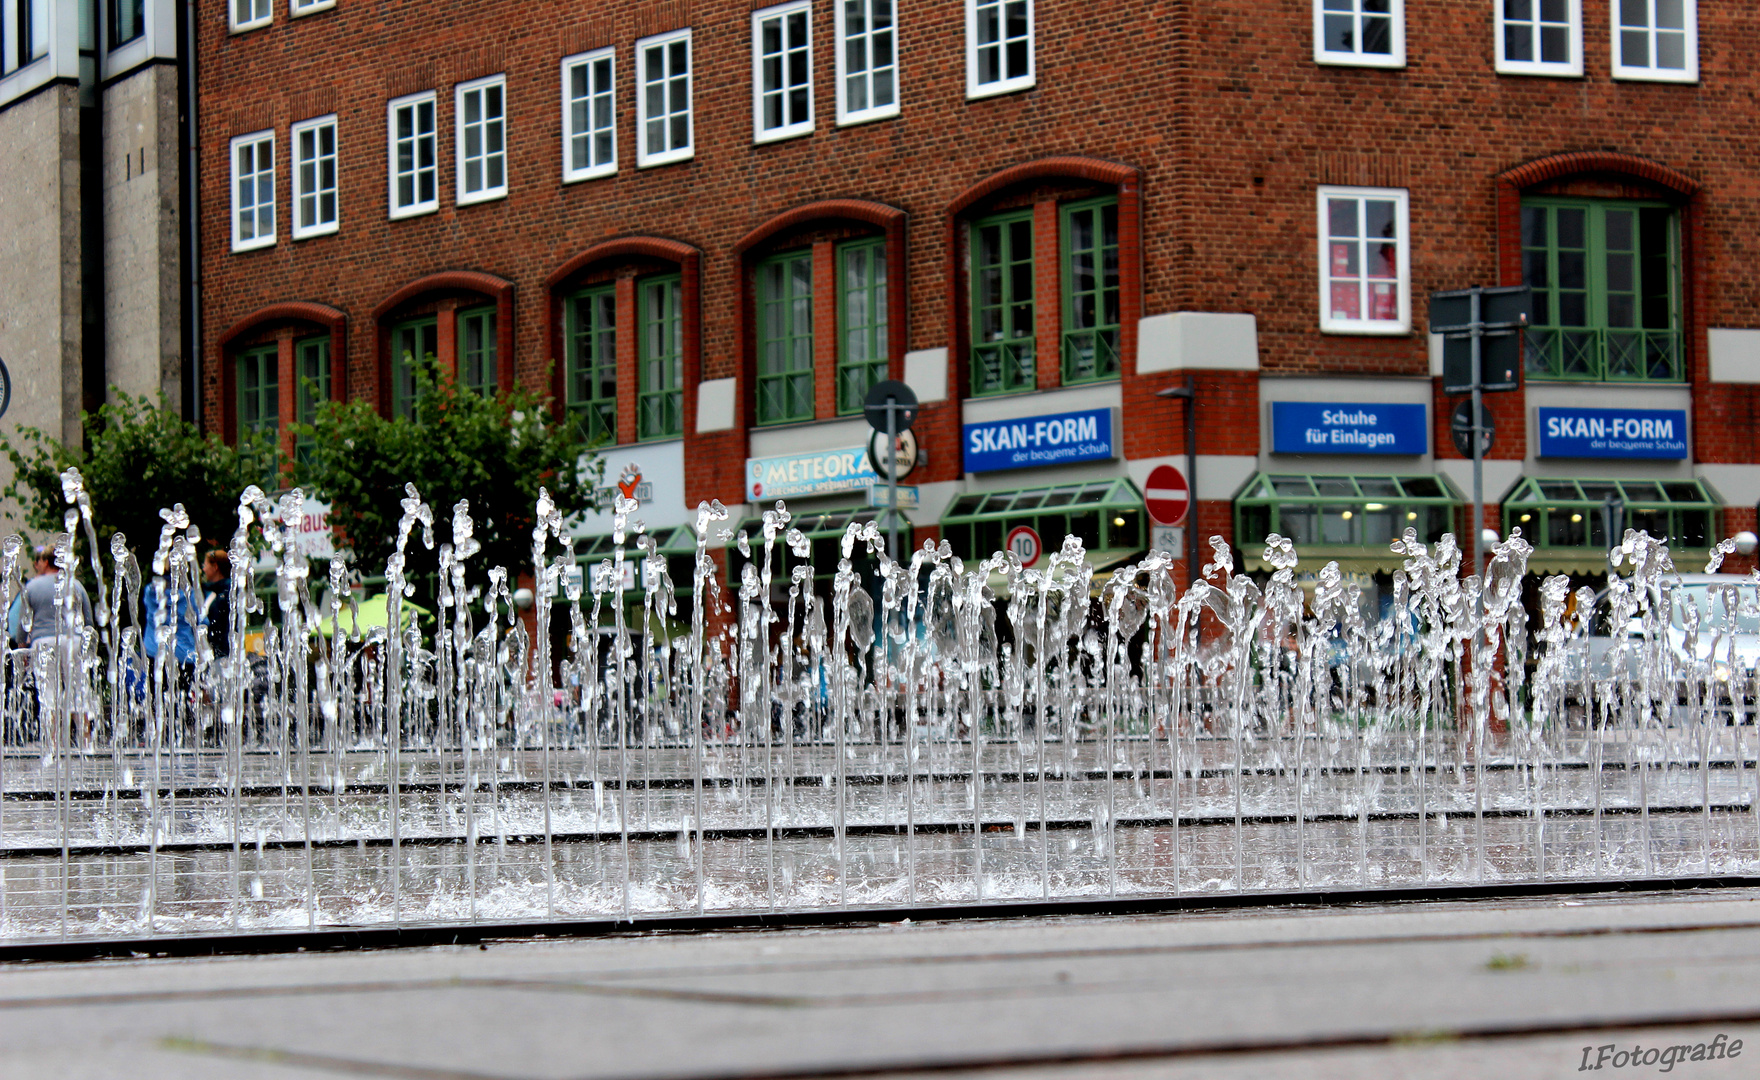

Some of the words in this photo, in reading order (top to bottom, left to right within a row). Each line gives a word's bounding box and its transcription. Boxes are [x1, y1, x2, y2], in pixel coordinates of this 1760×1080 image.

[1321, 410, 1378, 425] Schuhe
[1547, 416, 1674, 439] SKAN-FORM
[970, 415, 1098, 454] SKAN-FORM
[1305, 428, 1329, 444] für
[1330, 429, 1396, 448] Einlagen
[1590, 439, 1607, 449] der
[1608, 439, 1655, 450] bequeme
[1655, 440, 1685, 450] Schuh
[1012, 450, 1029, 462] der
[1030, 447, 1077, 461] bequeme
[1078, 441, 1110, 456] Schuh
[766, 450, 874, 485] METEORA
[874, 488, 918, 501] MEORA
[1015, 538, 1033, 557] 10
